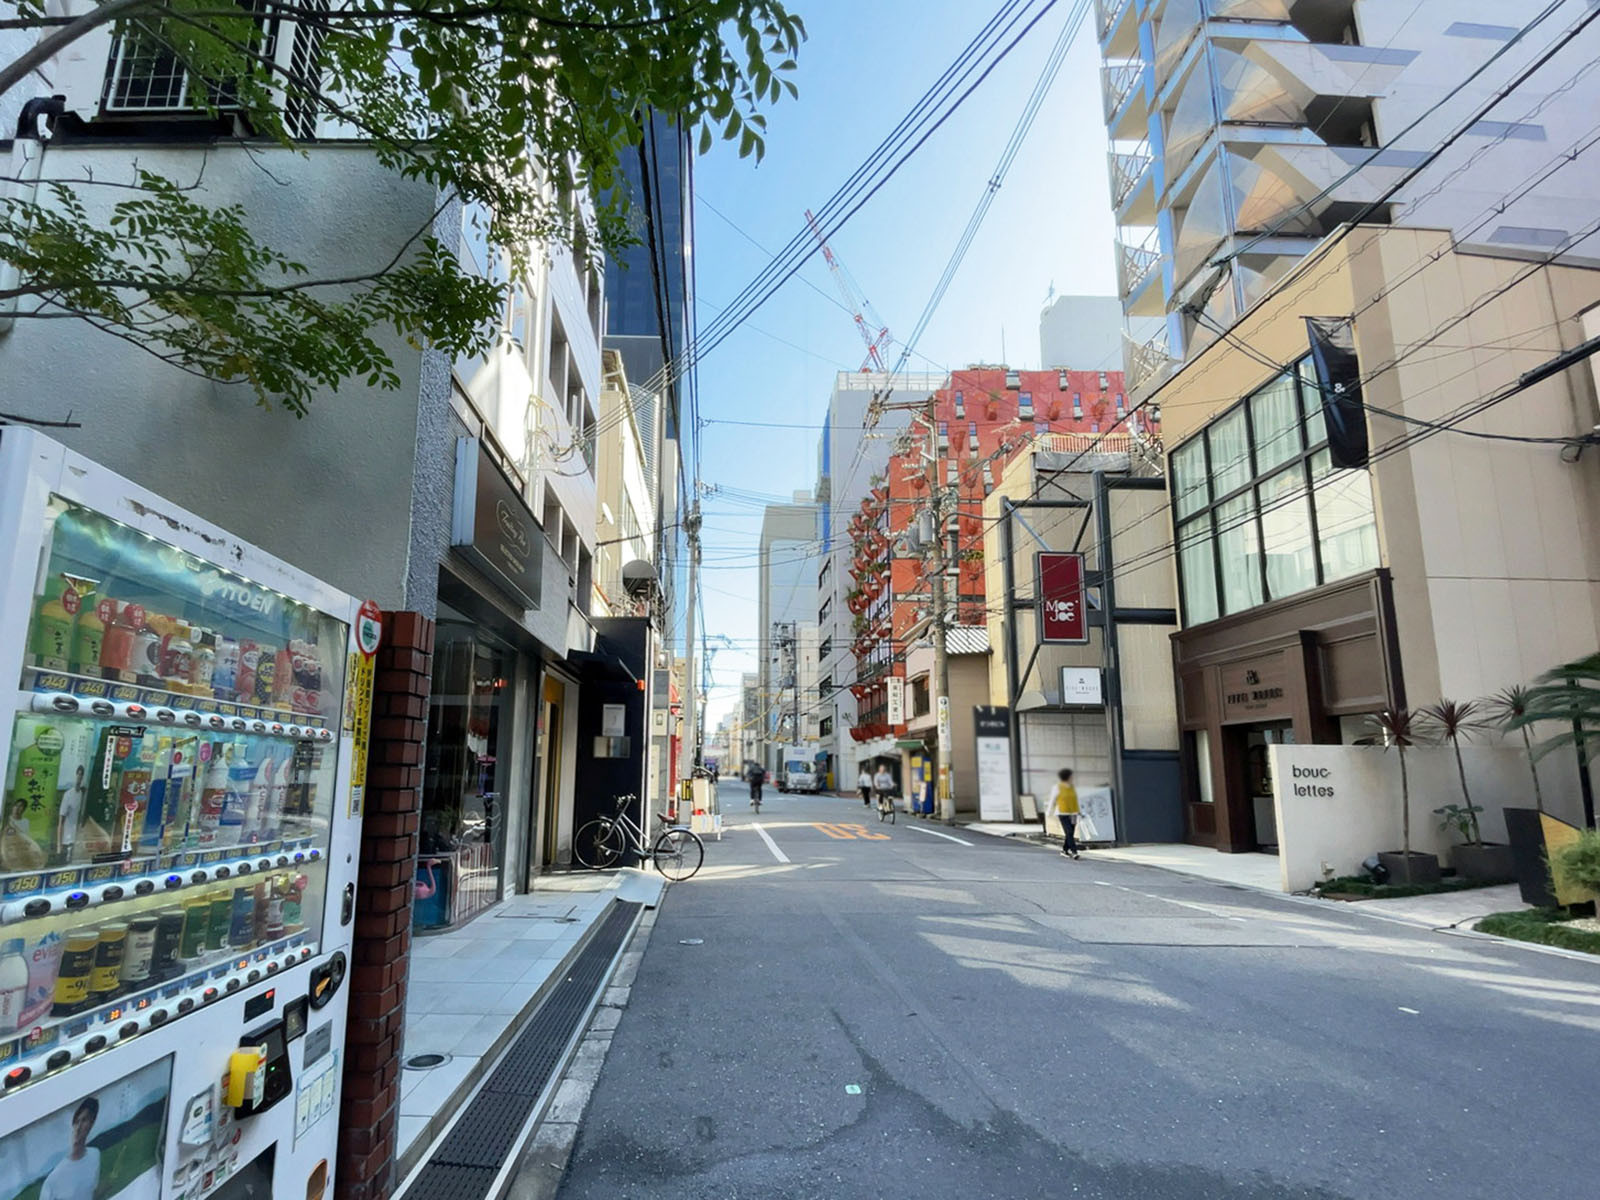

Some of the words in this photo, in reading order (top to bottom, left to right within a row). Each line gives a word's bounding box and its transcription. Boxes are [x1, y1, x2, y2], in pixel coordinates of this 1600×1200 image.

[221, 583, 250, 606] ITO
[250, 594, 273, 615] EN
[1292, 764, 1331, 778] bouc-
[1294, 783, 1334, 797] lettes
